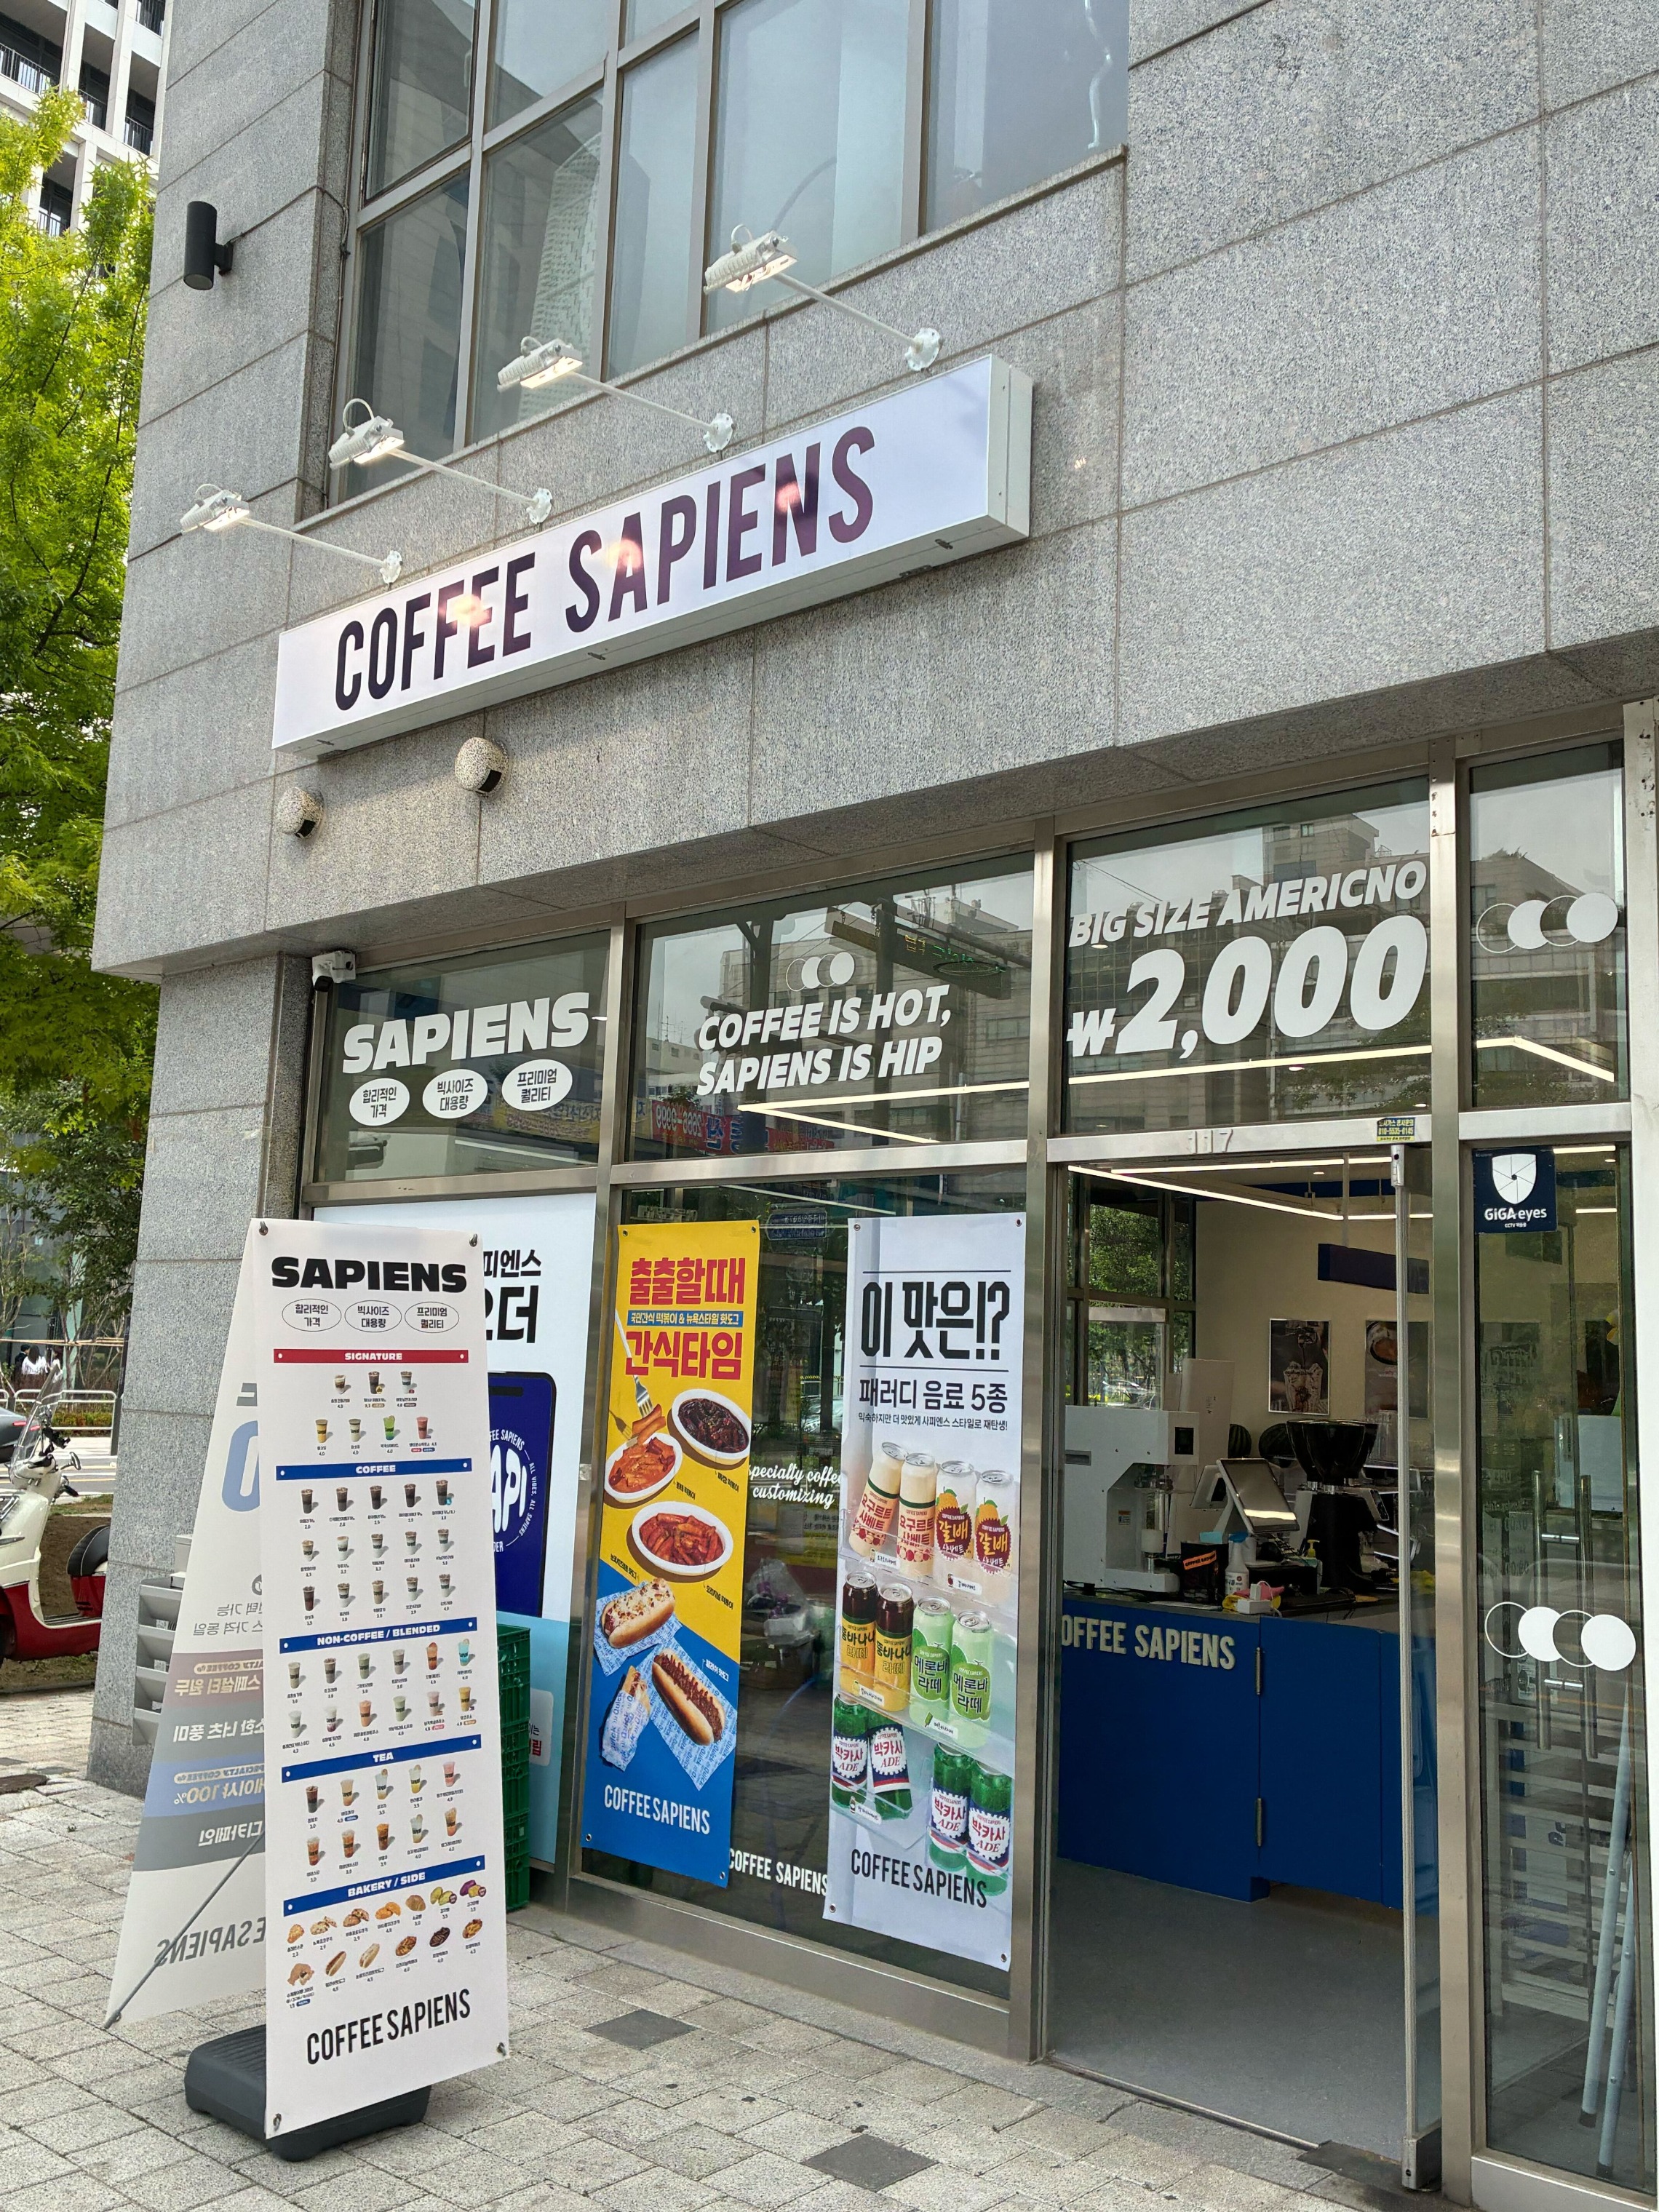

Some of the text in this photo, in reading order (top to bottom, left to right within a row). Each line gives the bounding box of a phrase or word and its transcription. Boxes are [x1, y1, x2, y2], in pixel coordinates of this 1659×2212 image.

[335, 426, 875, 712] COFFEE SAPIENS
[1068, 861, 1426, 947] BIG SIZE AMERICNO
[699, 984, 951, 1051] COFFEE IS HOT,
[343, 992, 589, 1073] SAPIENS
[696, 1036, 942, 1096] SAPIENS IS HIP
[437, 1078, 473, 1094] 빅사이즈
[517, 1069, 557, 1086] 프리미엄
[362, 1086, 397, 1105] 합리적인
[440, 1094, 469, 1111] 대용량
[521, 1086, 551, 1104] 퀄리티
[372, 1102, 387, 1118] 가격
[1188, 1129, 1233, 1154] 117
[271, 1257, 467, 1293] SAPIENS
[630, 1257, 746, 1305] 출출할때
[295, 1304, 447, 1317] 합리적인 빅사이즈 프리미엄
[631, 1312, 739, 1325] 국민간식 떡볶이 & 뉴욕스타일 핫도그
[862, 1281, 893, 1357] 이
[303, 1317, 321, 1328] 가격
[361, 1318, 386, 1329] 대용량
[344, 1352, 402, 1361] SIGNATURE
[625, 1331, 743, 1380] 간식타임
[859, 1379, 1008, 1413] 패러디 음료 5종
[858, 1412, 1008, 1431] 익숙하지만 더 맛있게 사피엔스 스타일로 재탄생!
[501, 1429, 525, 1451] SAPIENS
[356, 1465, 396, 1474] COFFEE
[752, 1482, 835, 1510] customizing
[862, 1494, 892, 1519] 요구르트
[900, 1515, 934, 1532] 요구르트
[939, 1519, 968, 1543] 갈배
[979, 1532, 1008, 1556] 갈배
[317, 1631, 383, 1646] NON-COFFEE
[392, 1625, 441, 1636] BLENDED
[1062, 1614, 1236, 1670] OFFEE SAPIENS
[915, 1655, 947, 1676] 메론바
[918, 1675, 942, 1693] 라떼
[953, 1672, 988, 1695] 메론바
[958, 1693, 982, 1713] 라떼
[373, 1751, 394, 1762] TEA
[835, 1743, 864, 1762] 박카사
[874, 1740, 902, 1757] 박카사
[839, 1762, 859, 1772] ADE
[880, 1757, 901, 1767] ADE
[604, 1784, 710, 1835] COFFEE SAPIENS
[934, 1797, 966, 1821] 박카사
[938, 1819, 960, 1831] ADE
[972, 1816, 1006, 1842] 박카사
[976, 1839, 1000, 1853] ADE
[729, 1848, 828, 1897] COFFEE SAPIENS
[851, 1848, 987, 1909] COFFEE SAPIENS
[348, 1872, 426, 1897] BAKERY / SIDE
[307, 1989, 471, 2064] COFFEE SAPIENS
